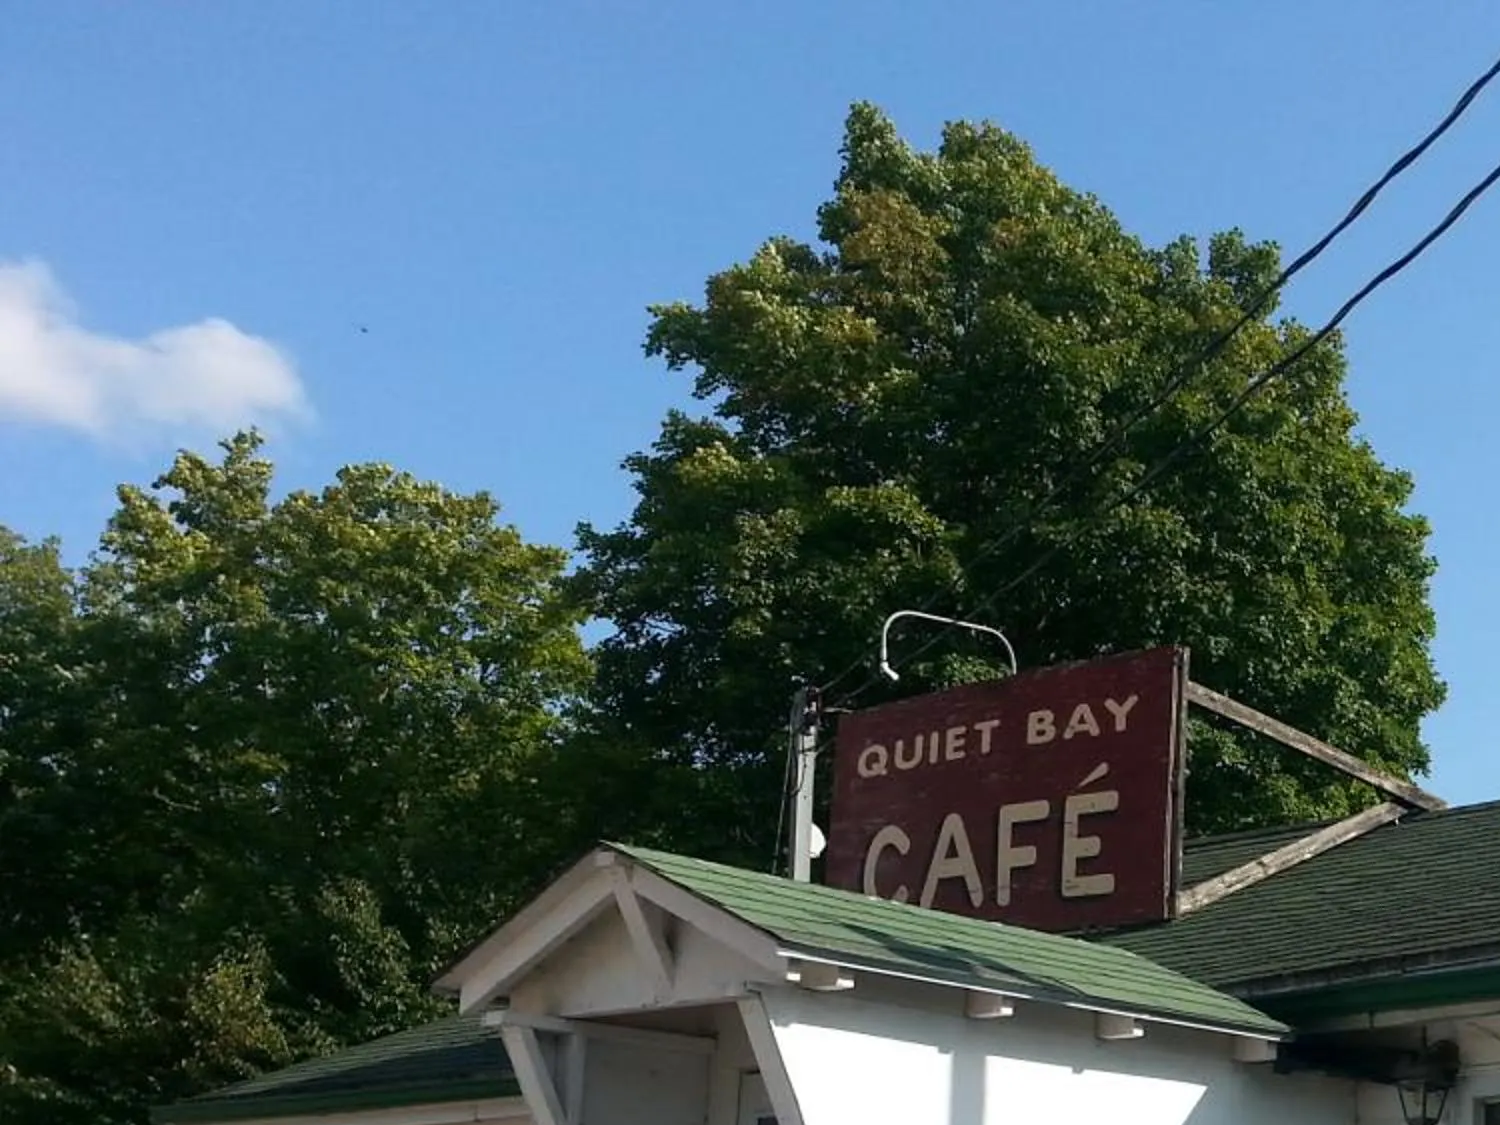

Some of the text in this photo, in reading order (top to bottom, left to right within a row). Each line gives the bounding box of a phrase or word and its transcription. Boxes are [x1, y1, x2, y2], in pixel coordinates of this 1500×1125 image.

[857, 694, 1139, 779] QUIET BAY
[862, 762, 1120, 909] CAFÉ
